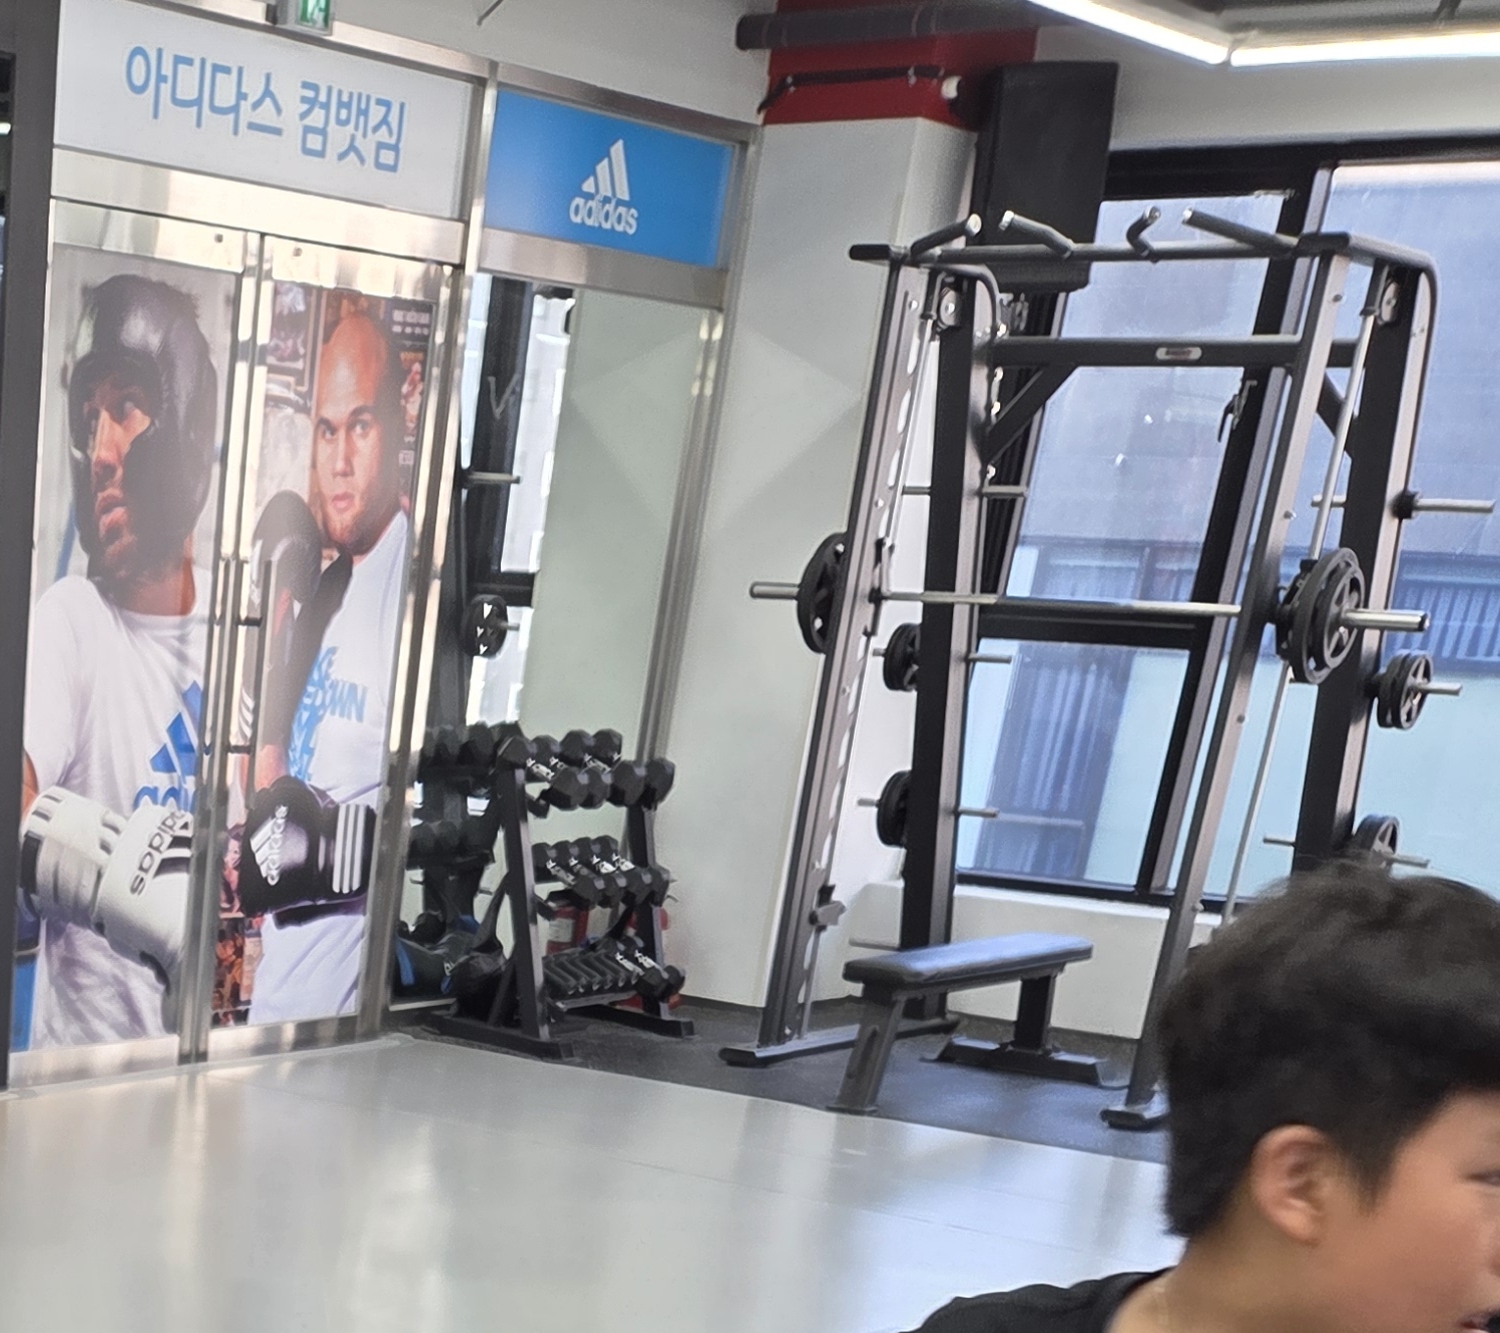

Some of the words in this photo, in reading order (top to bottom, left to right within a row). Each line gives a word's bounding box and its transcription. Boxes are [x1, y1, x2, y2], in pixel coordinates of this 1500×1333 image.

[125, 44, 285, 137] 아디다스
[298, 79, 407, 174] 컴뱃짐
[569, 190, 639, 236] adidas
[266, 804, 290, 887] adidas
